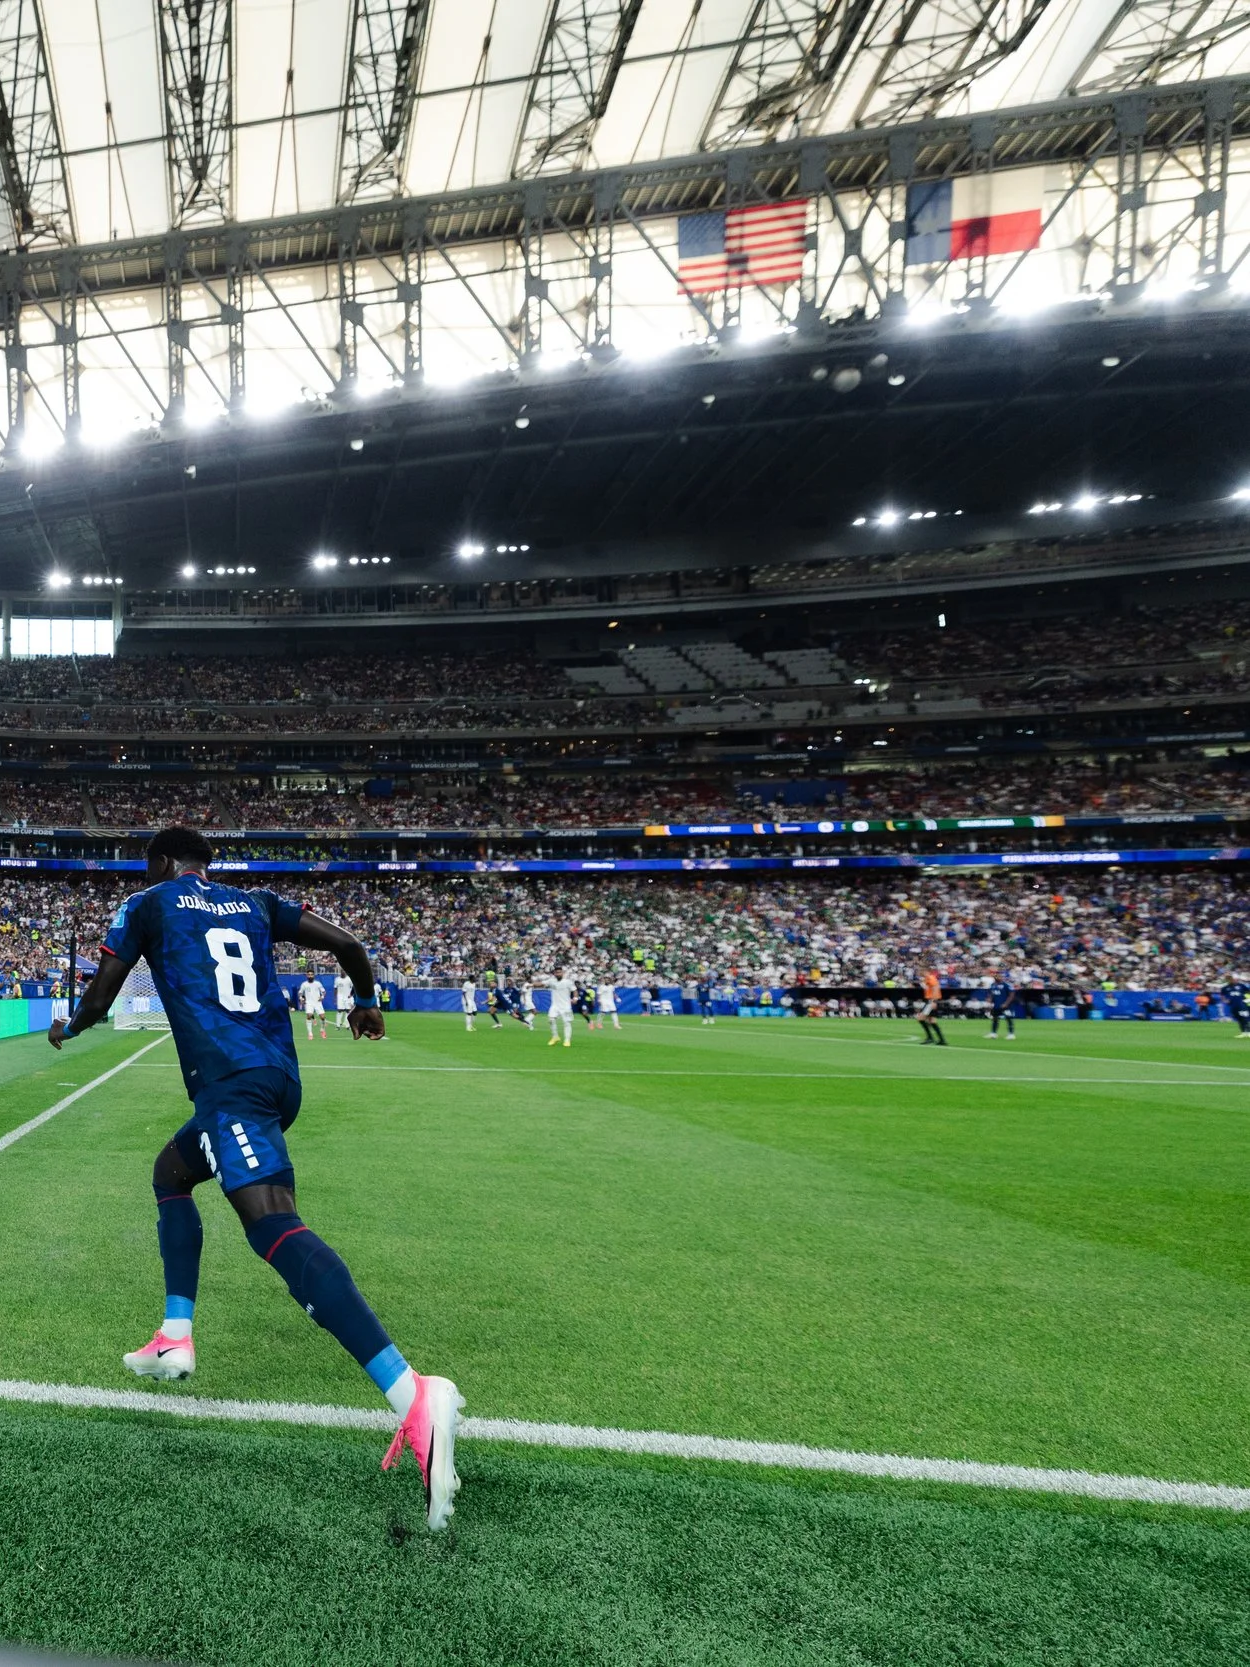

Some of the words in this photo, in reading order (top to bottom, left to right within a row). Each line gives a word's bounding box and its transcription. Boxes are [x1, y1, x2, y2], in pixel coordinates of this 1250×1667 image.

[0, 859, 37, 868] HOUSTON
[177, 894, 211, 912] JOÃO
[204, 928, 261, 1013] 8
